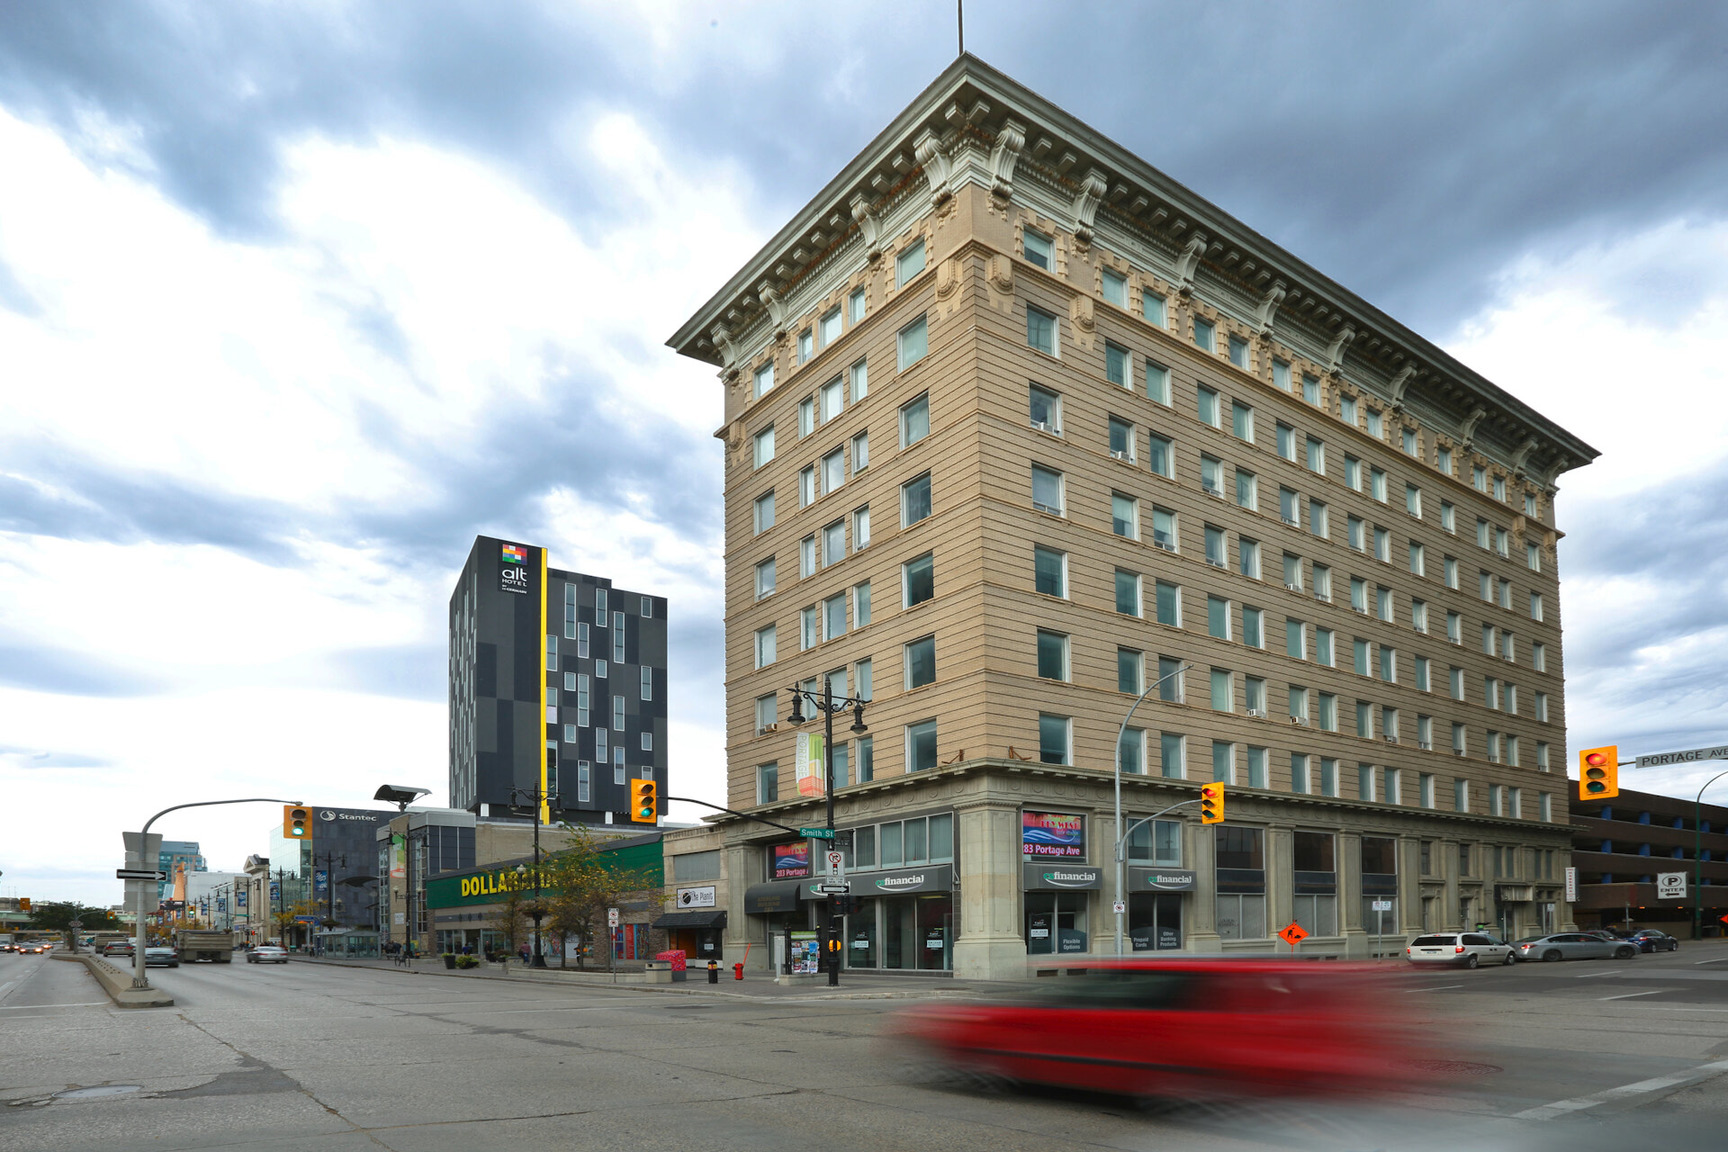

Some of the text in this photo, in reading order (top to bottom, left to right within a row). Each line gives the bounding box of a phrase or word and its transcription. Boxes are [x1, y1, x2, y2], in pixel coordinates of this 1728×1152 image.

[502, 567, 527, 582] alt
[502, 579, 527, 587] HOTEL
[798, 735, 807, 778] PORTAGE
[1642, 748, 1728, 766] PORTAGE AVE
[339, 813, 377, 821] Stantec
[801, 829, 822, 837] Smith
[1035, 844, 1065, 856] Portage
[1066, 846, 1080, 855] Ave
[786, 868, 806, 877] Portage
